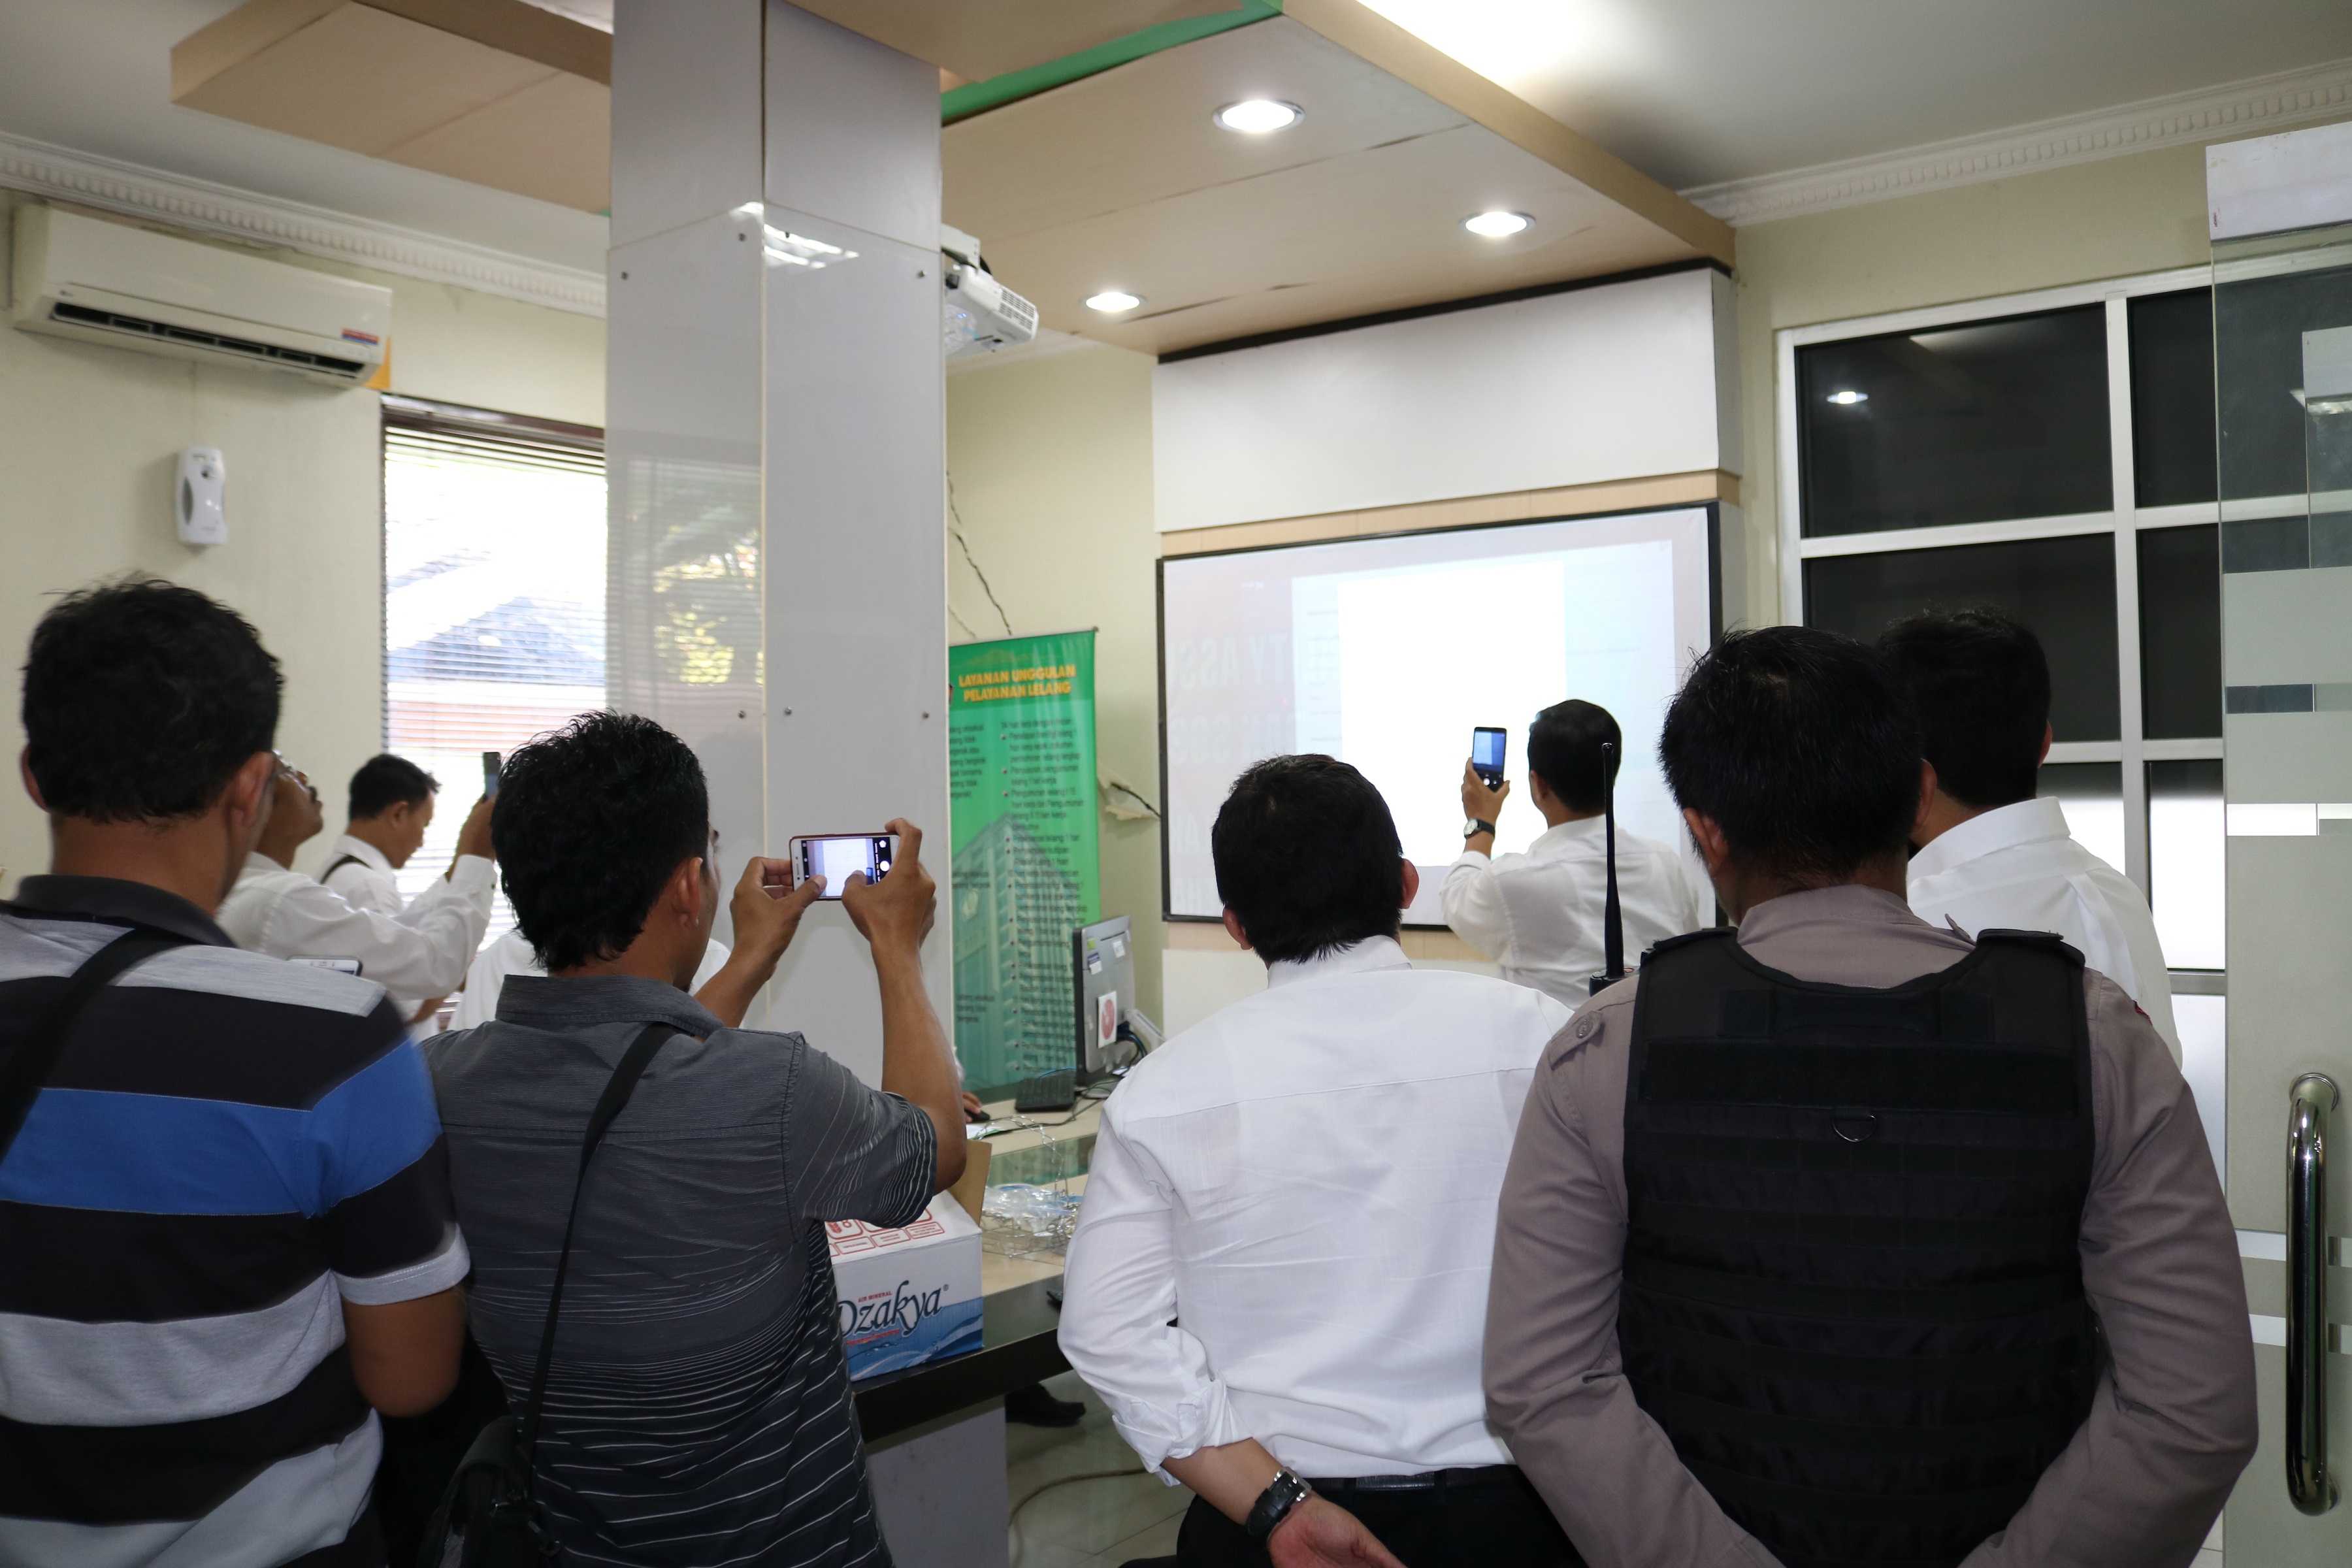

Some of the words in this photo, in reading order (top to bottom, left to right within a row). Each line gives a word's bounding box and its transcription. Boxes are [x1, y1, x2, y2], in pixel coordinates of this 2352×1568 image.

[958, 670, 1009, 688] LAYANAN
[1011, 664, 1076, 681] UNGGULAN
[964, 684, 1027, 702] PELAYANAN
[1028, 681, 1072, 697] LELANG
